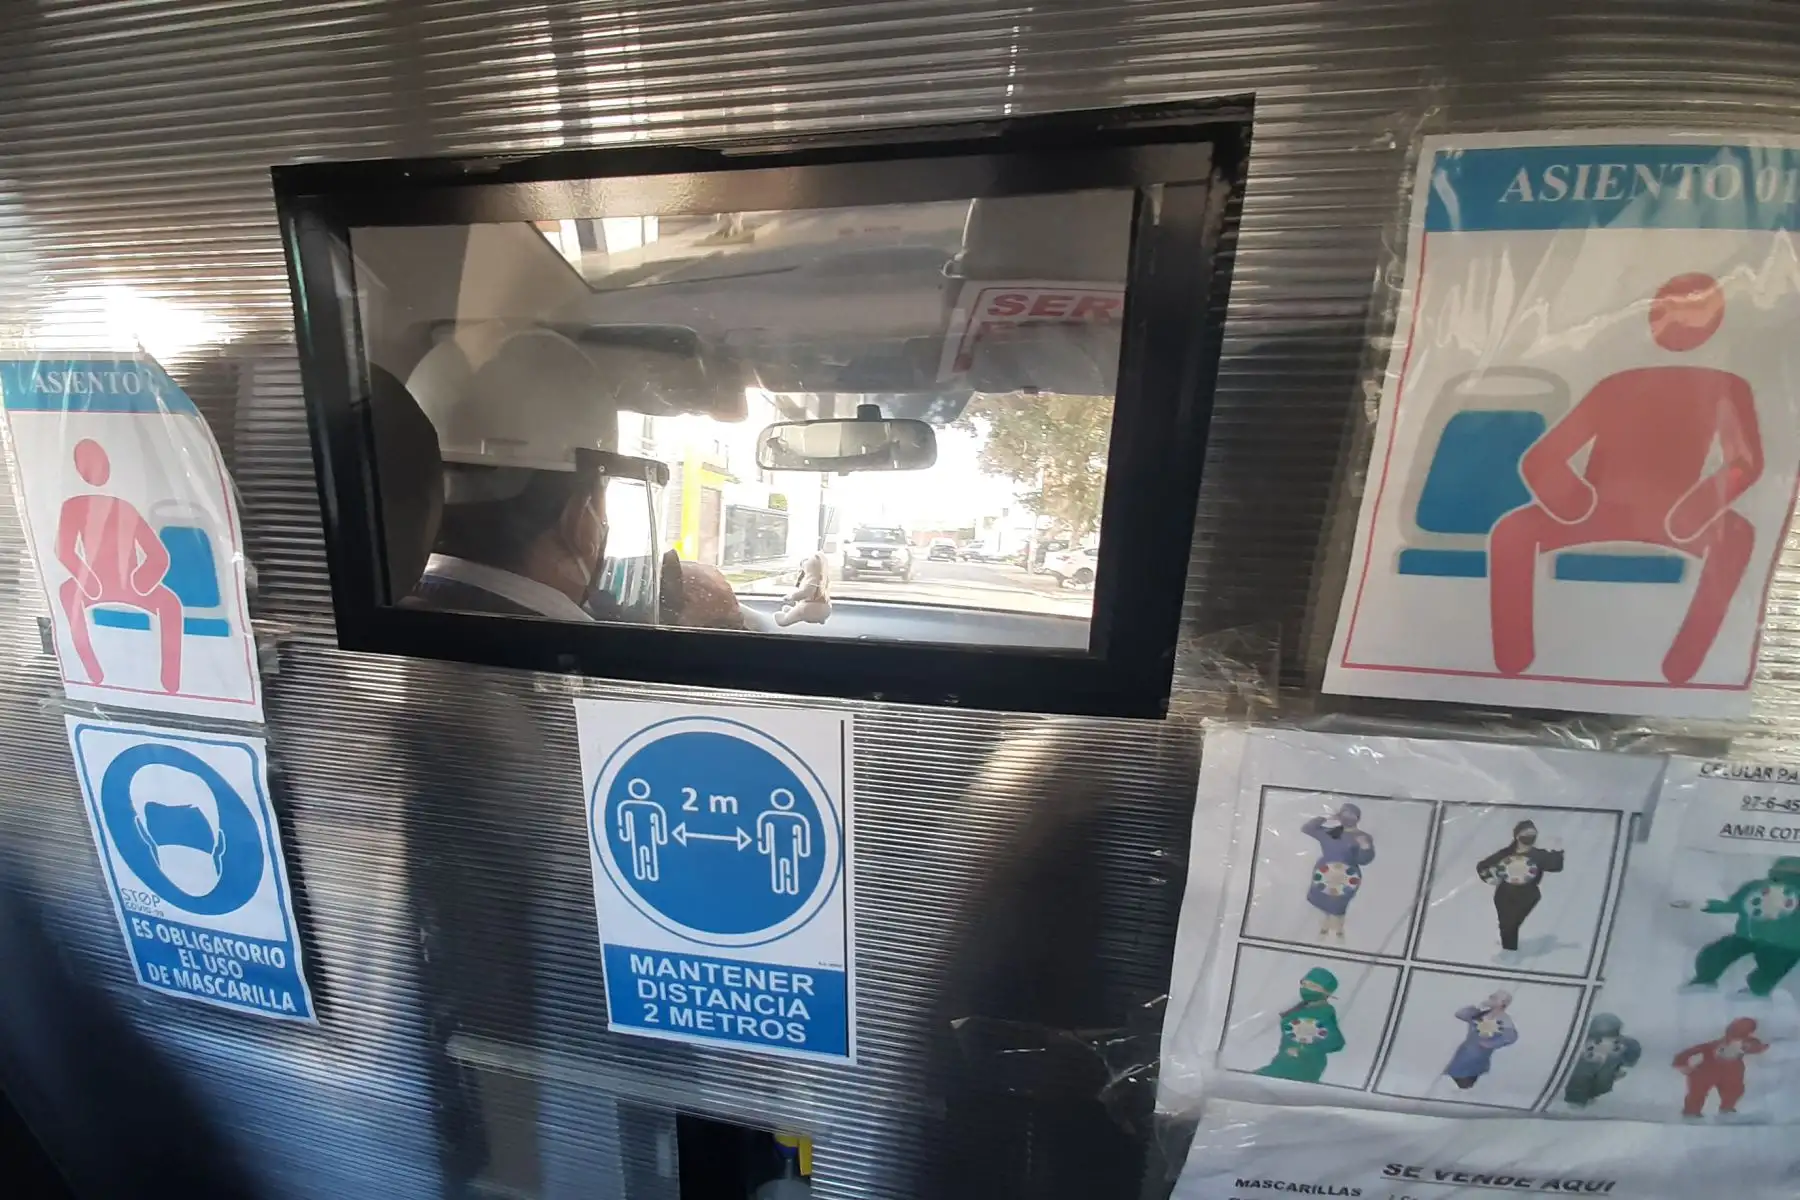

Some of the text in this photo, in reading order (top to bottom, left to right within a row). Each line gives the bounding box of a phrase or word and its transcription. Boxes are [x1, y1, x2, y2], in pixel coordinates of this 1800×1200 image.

[1499, 163, 1743, 203] ASIENTO
[32, 369, 141, 395] ASIENTO
[681, 786, 738, 815] 2 m
[1720, 823, 1765, 838] AMIR
[121, 888, 161, 908] STOP
[131, 917, 286, 969] ES OBLIGATORIO
[178, 947, 243, 980] EL USO
[629, 953, 815, 996] MANTENER
[147, 962, 297, 1013] DE MASCARILLA
[637, 978, 811, 1021] DISTANCIA
[643, 1003, 807, 1043] 2 METROS
[1234, 1178, 1363, 1197] MASCARILLAS
[1382, 1163, 1617, 1193] SE VENDE AQUI
